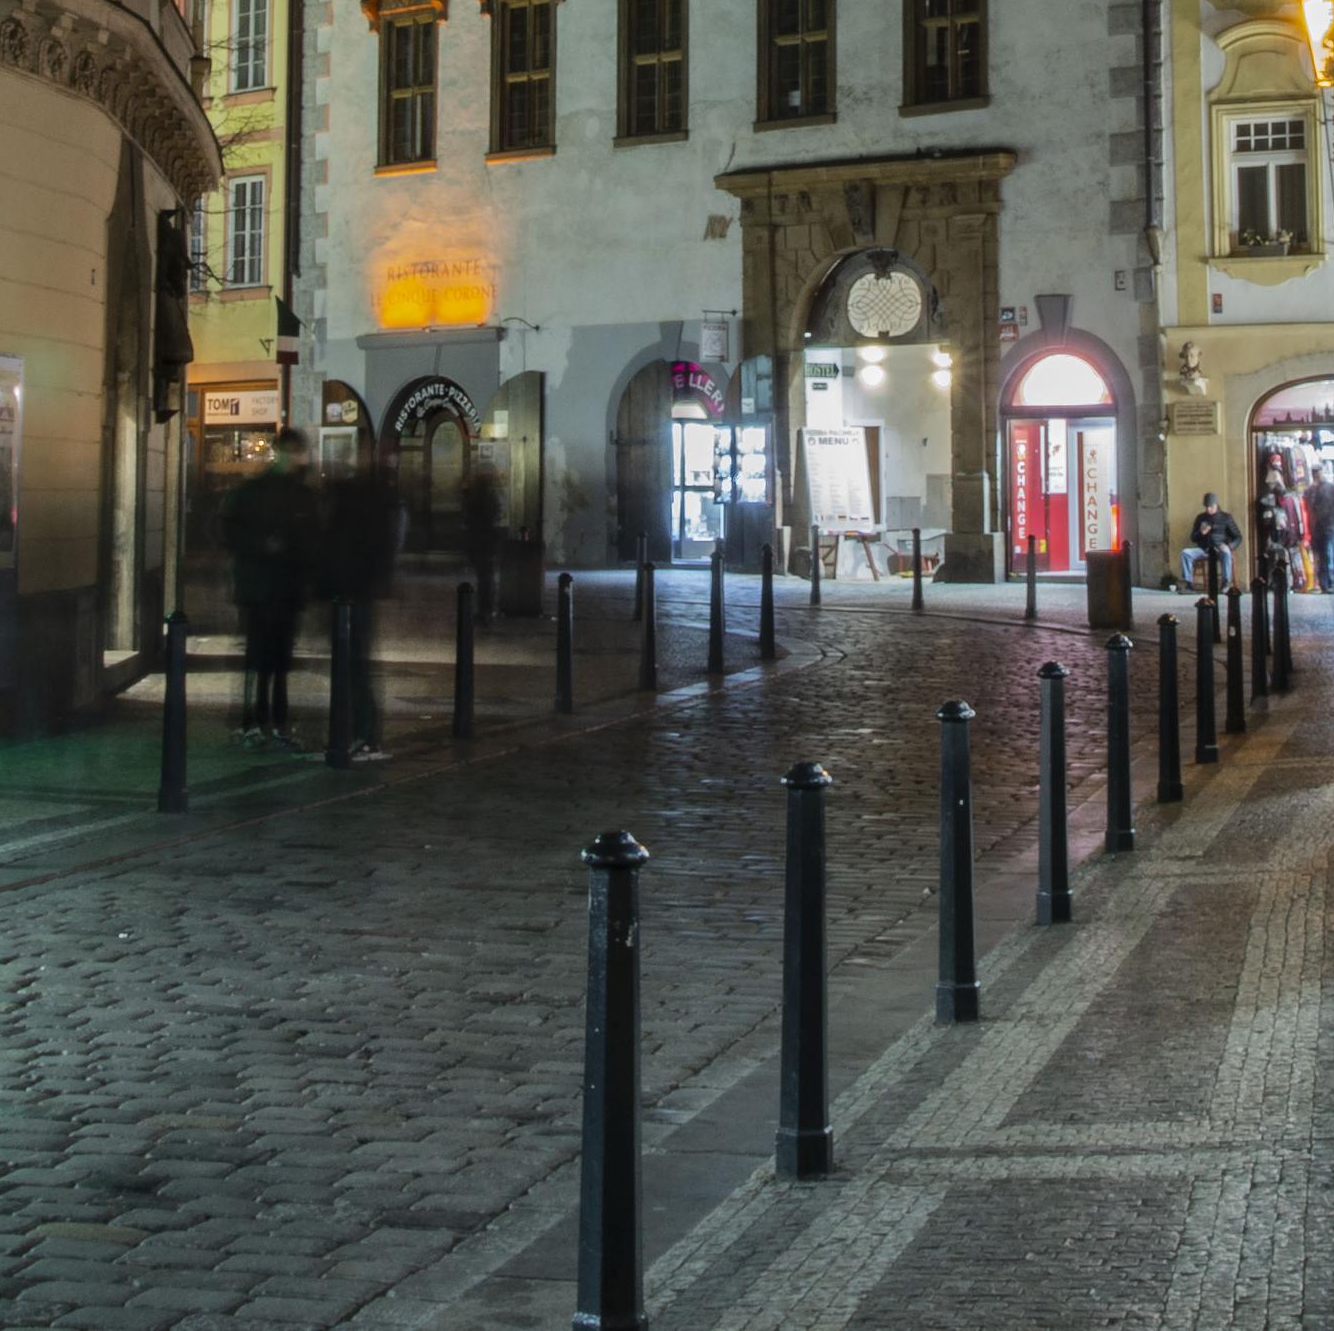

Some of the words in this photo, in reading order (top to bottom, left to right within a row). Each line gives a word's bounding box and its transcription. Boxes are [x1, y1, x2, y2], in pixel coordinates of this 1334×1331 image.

[387, 259, 482, 282] RISTORANTE
[370, 293, 382, 307] LE
[387, 289, 436, 306] CINQUE
[444, 283, 496, 302] CORONE
[395, 383, 445, 431] RISTORANTE
[448, 386, 482, 433] PIZZERIA
[818, 436, 849, 446] MENU
[1017, 461, 1026, 539] CHANGE
[1087, 468, 1098, 549] CHANGE
